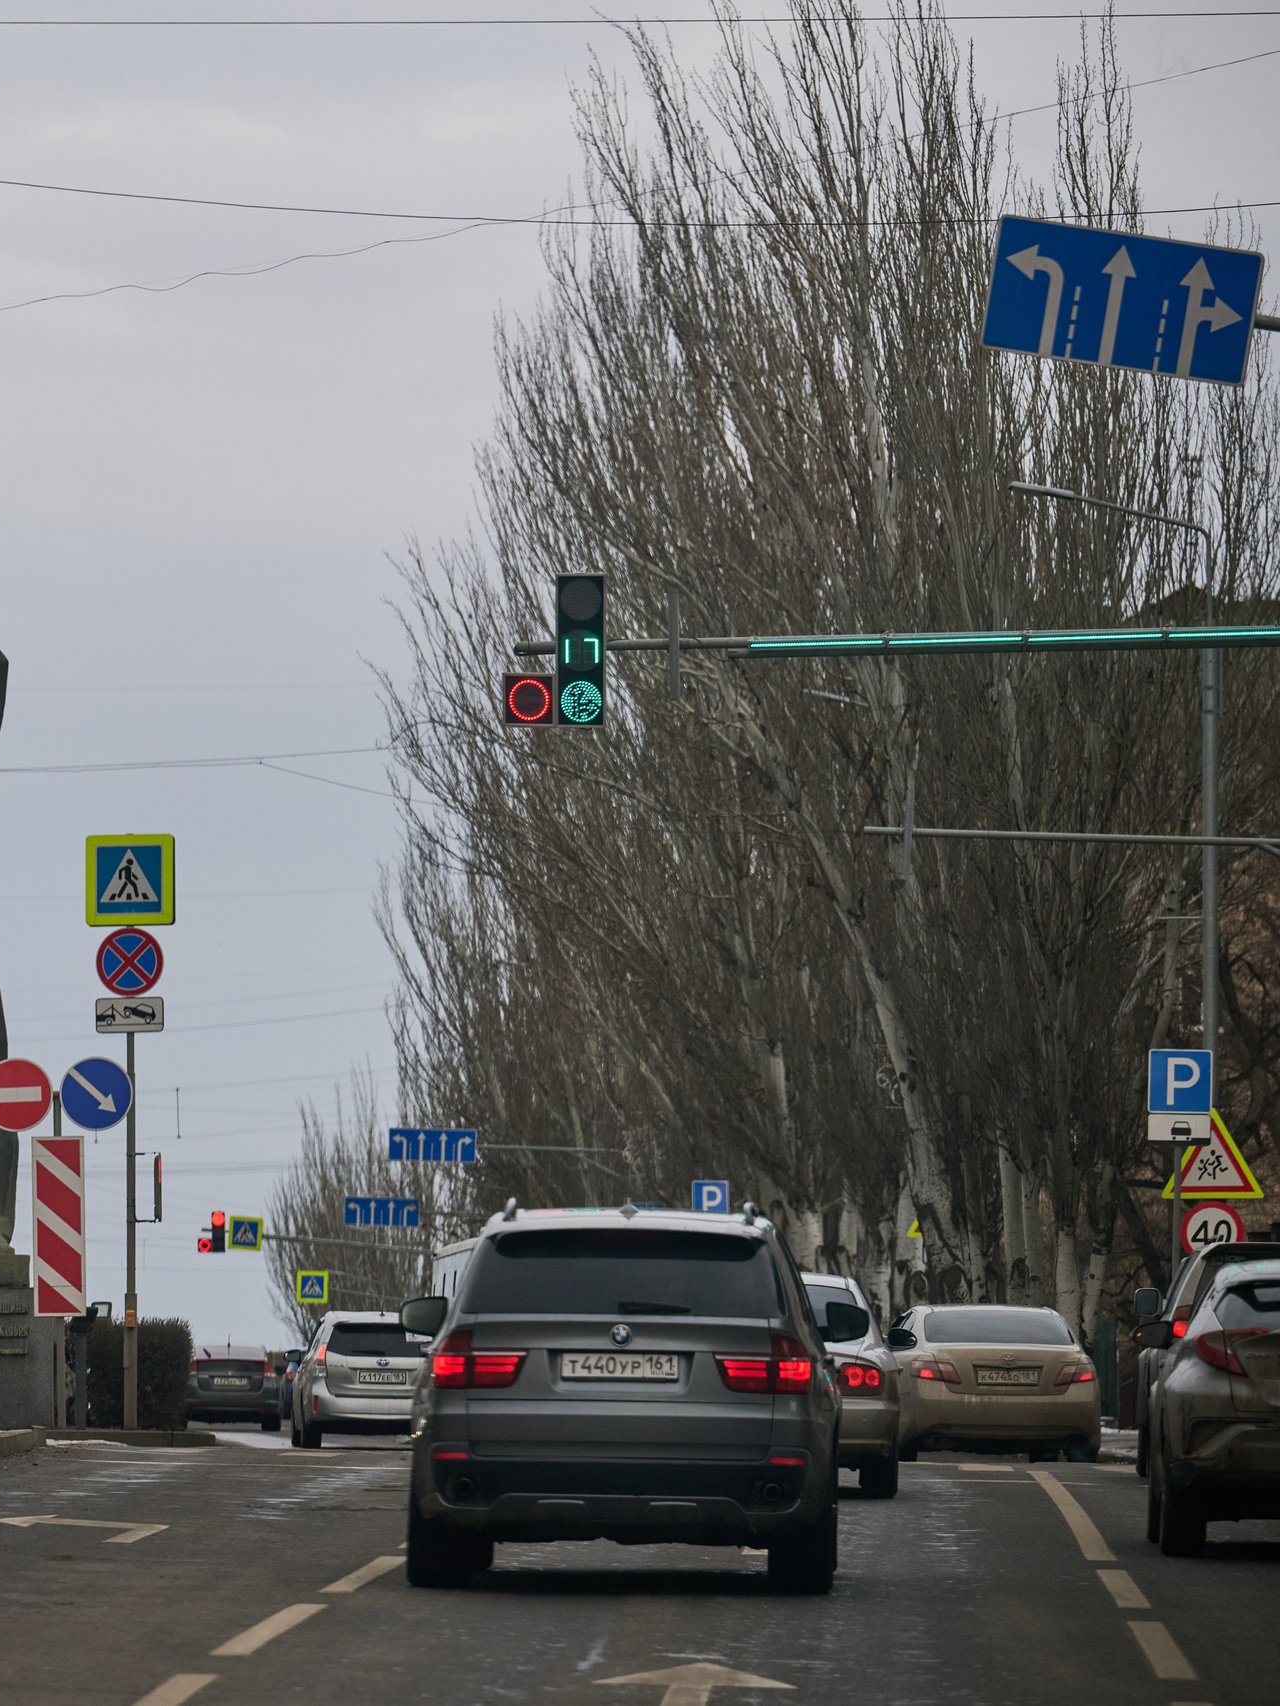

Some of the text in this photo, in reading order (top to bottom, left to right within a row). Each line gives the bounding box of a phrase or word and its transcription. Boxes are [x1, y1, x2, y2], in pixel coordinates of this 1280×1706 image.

[565, 638, 600, 664] 17
[1166, 1057, 1201, 1106] P
[702, 1185, 723, 1212] P
[1190, 1219, 1233, 1246] 40
[568, 1355, 674, 1375] Т440УР 161
